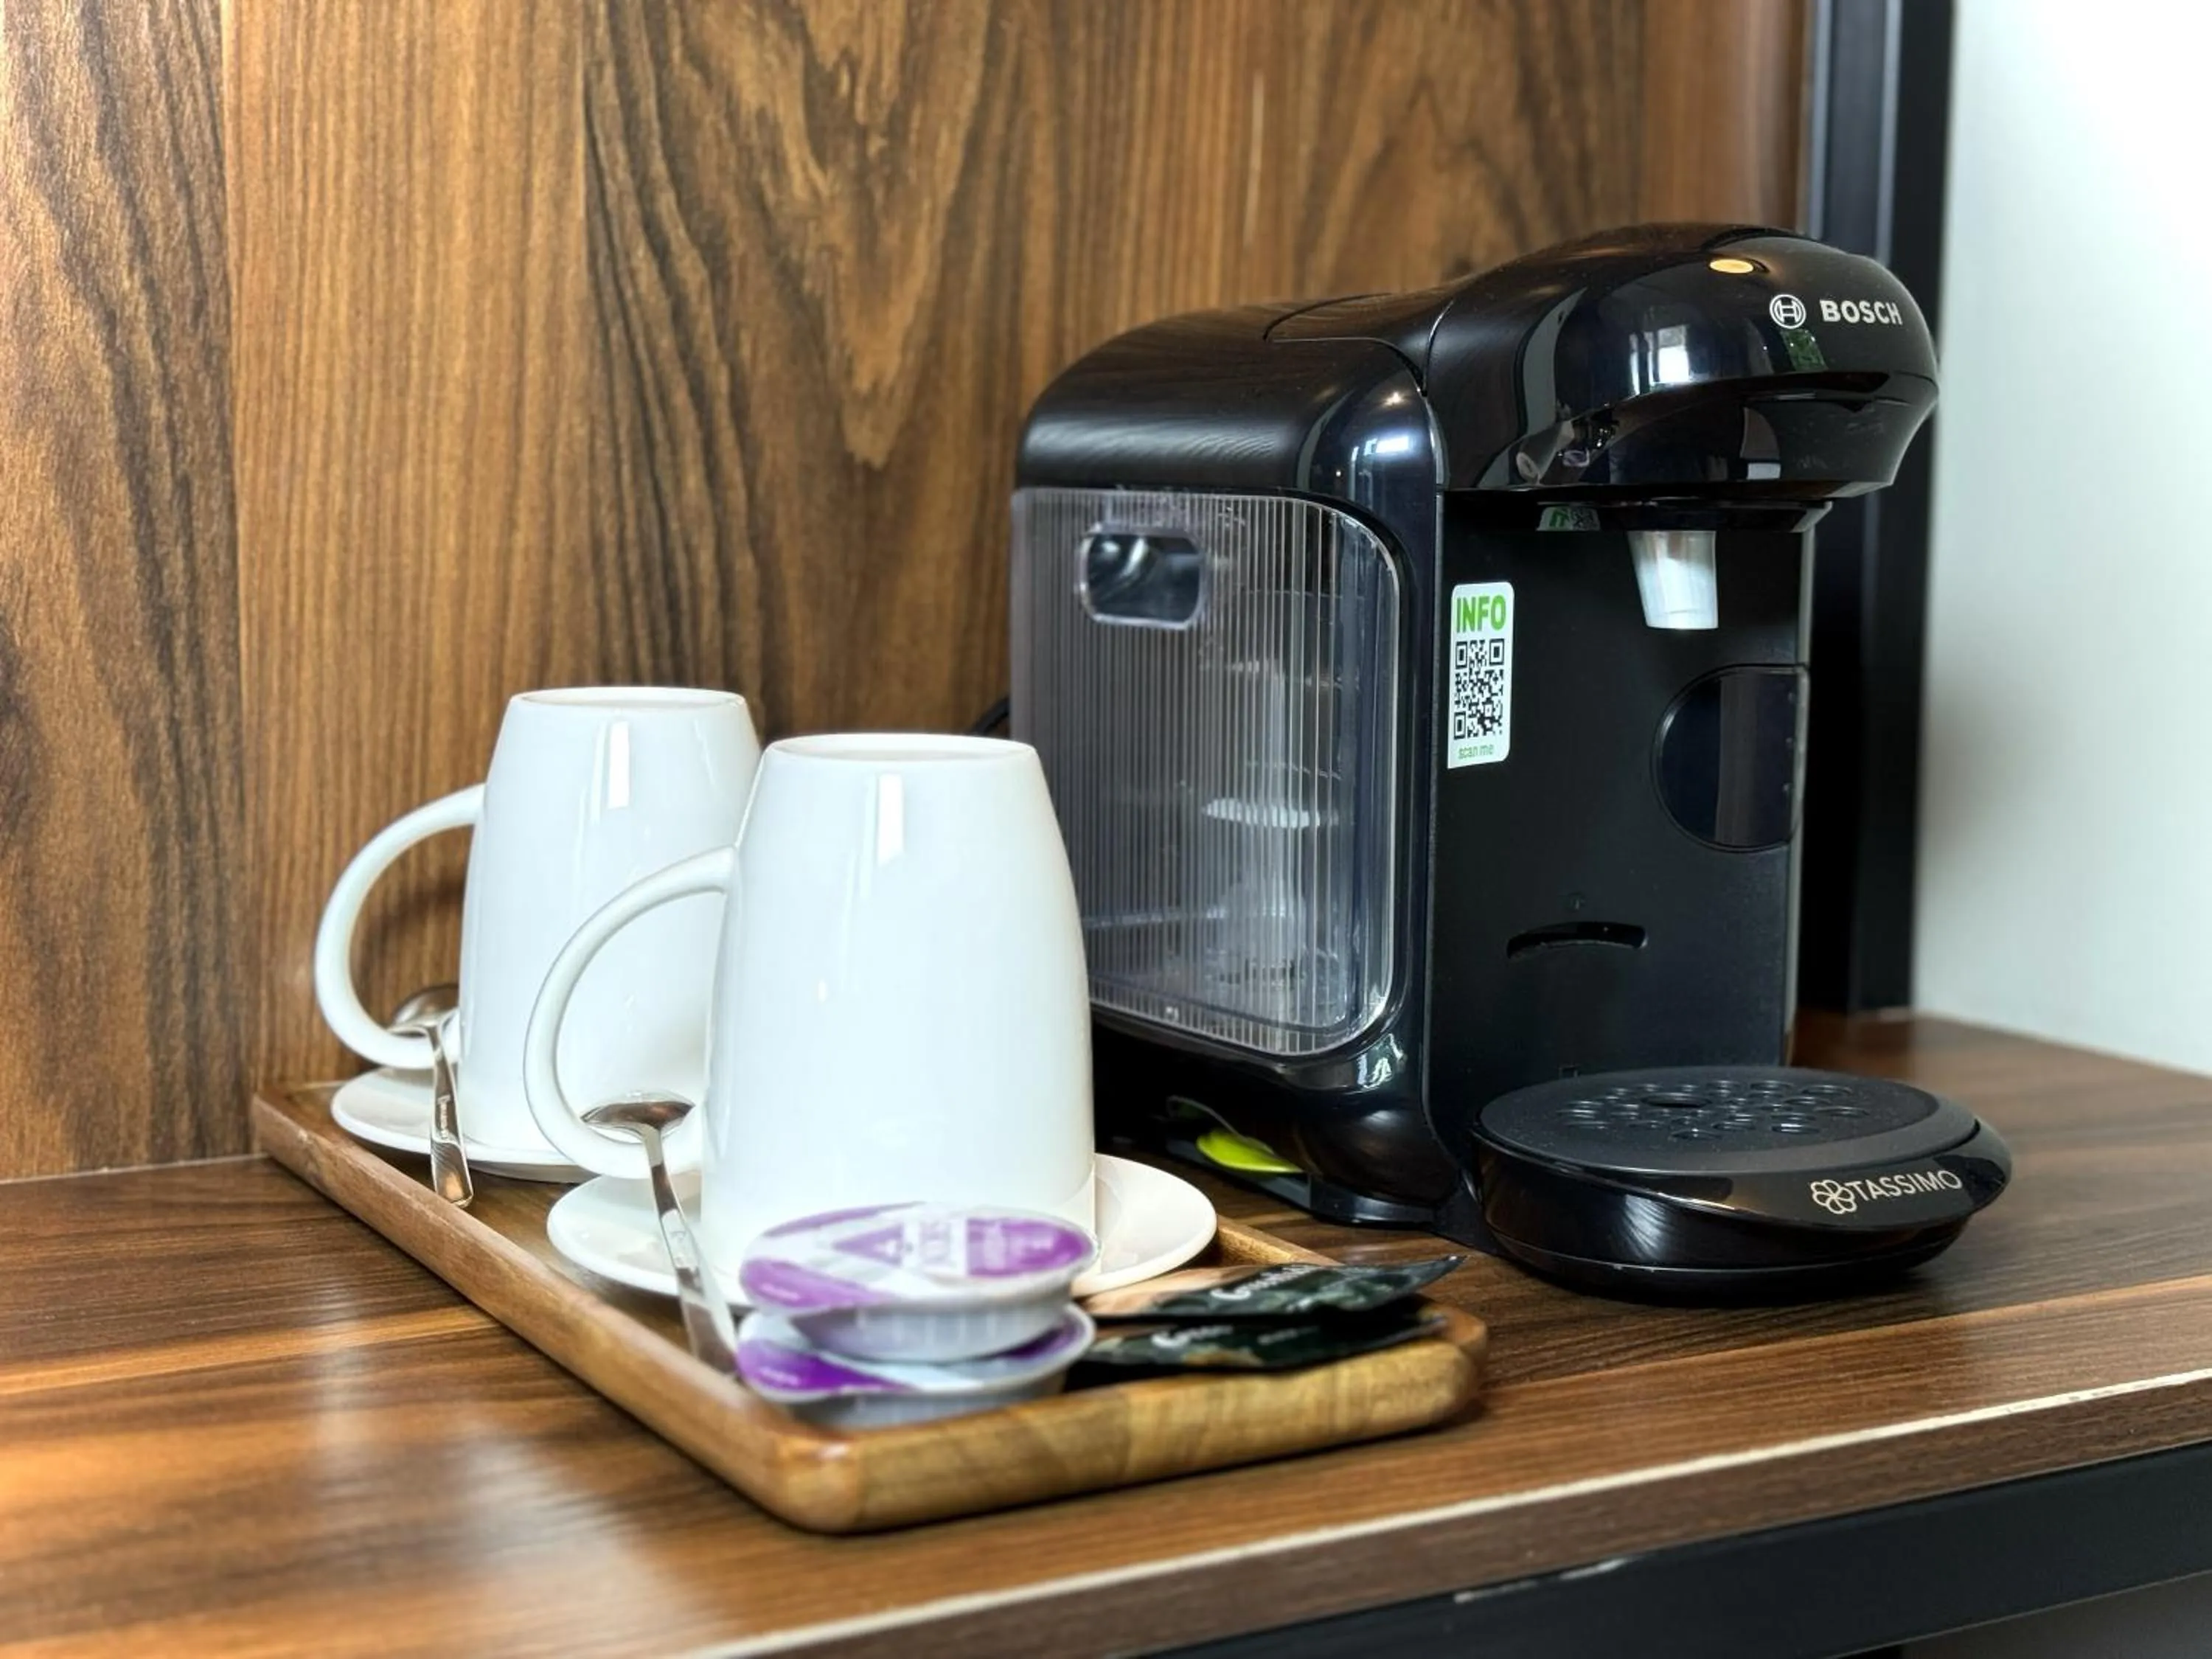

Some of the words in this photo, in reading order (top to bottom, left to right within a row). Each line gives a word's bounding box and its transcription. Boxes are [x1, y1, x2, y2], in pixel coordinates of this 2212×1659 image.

[1820, 299, 1903, 325] BOSCH
[1456, 594, 1507, 633] INFO
[1458, 745, 1478, 759] scan
[1479, 744, 1494, 756] me
[1844, 1169, 1963, 1202] TASSIMO
